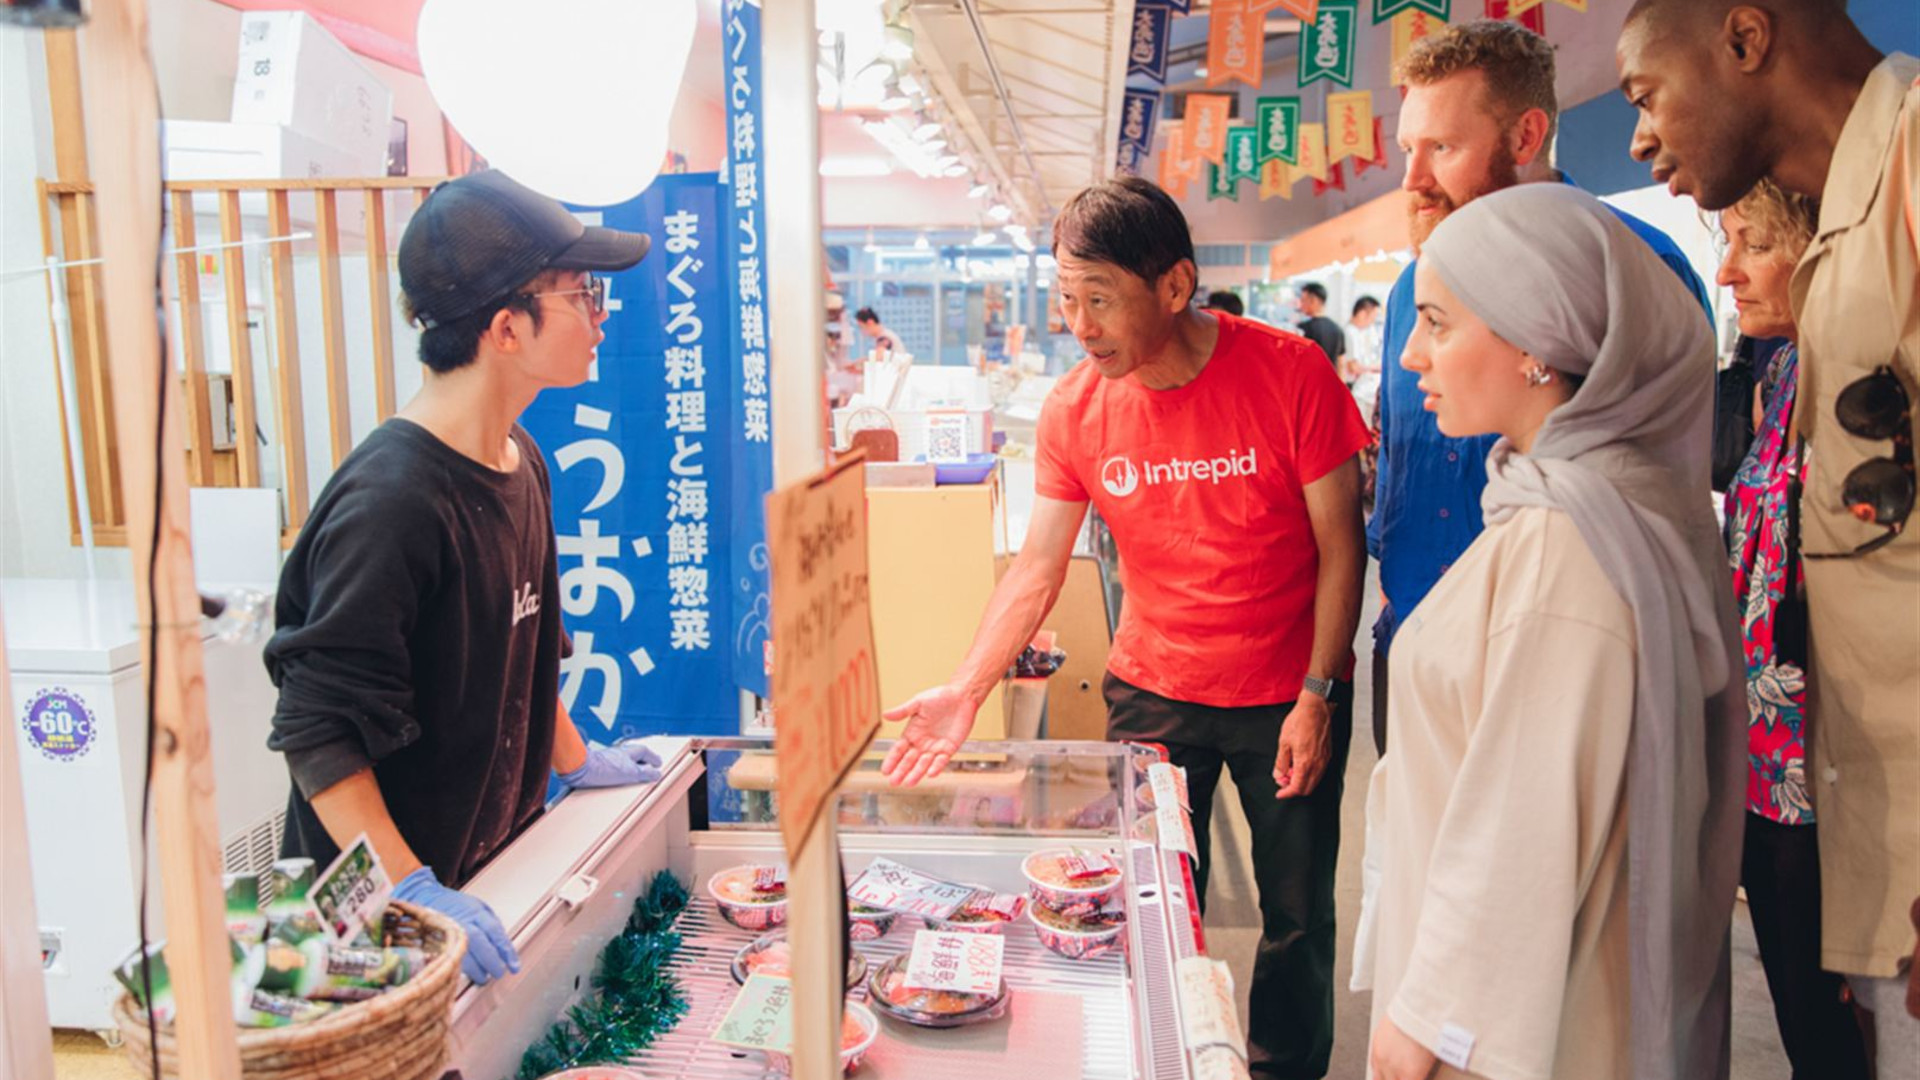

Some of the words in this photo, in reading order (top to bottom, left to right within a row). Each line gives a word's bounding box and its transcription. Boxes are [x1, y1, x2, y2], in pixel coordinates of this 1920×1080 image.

[663, 209, 711, 651] まぐろ料理と海鮮惣菜
[1143, 447, 1258, 486] Intrepid
